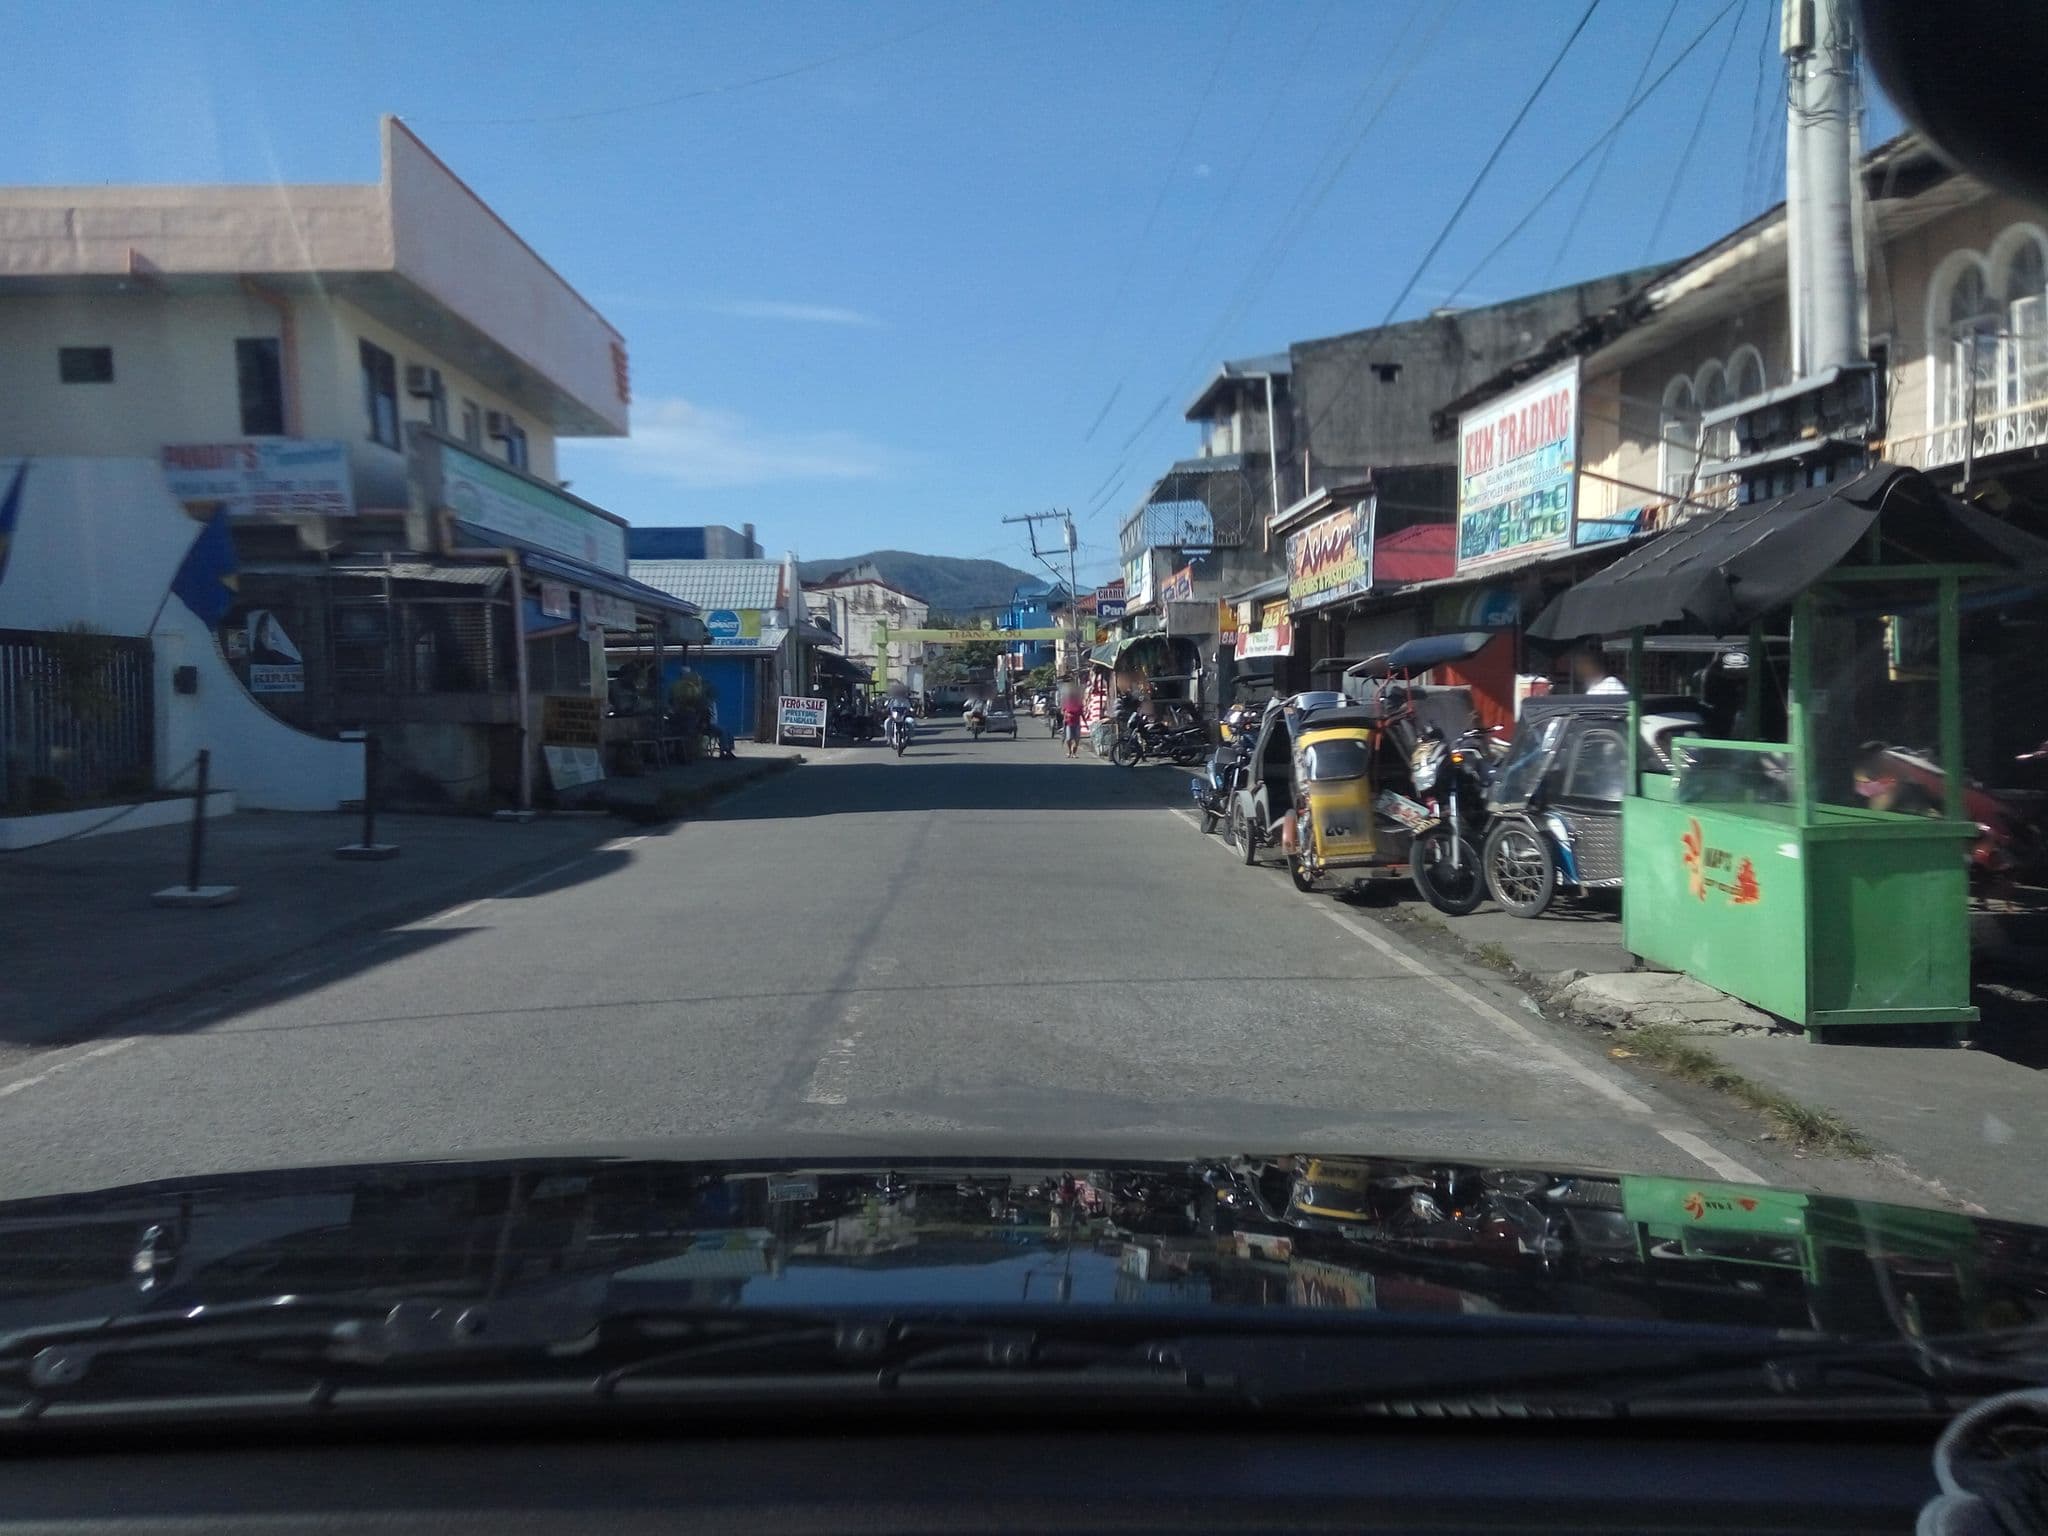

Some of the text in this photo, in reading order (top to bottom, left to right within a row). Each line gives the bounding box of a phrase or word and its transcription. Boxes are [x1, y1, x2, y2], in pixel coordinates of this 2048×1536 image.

[1465, 388, 1569, 475] KHM TRADING
[948, 630, 1023, 640] THANK YOU
[780, 698, 801, 709] YERO
[805, 700, 825, 711] SALE
